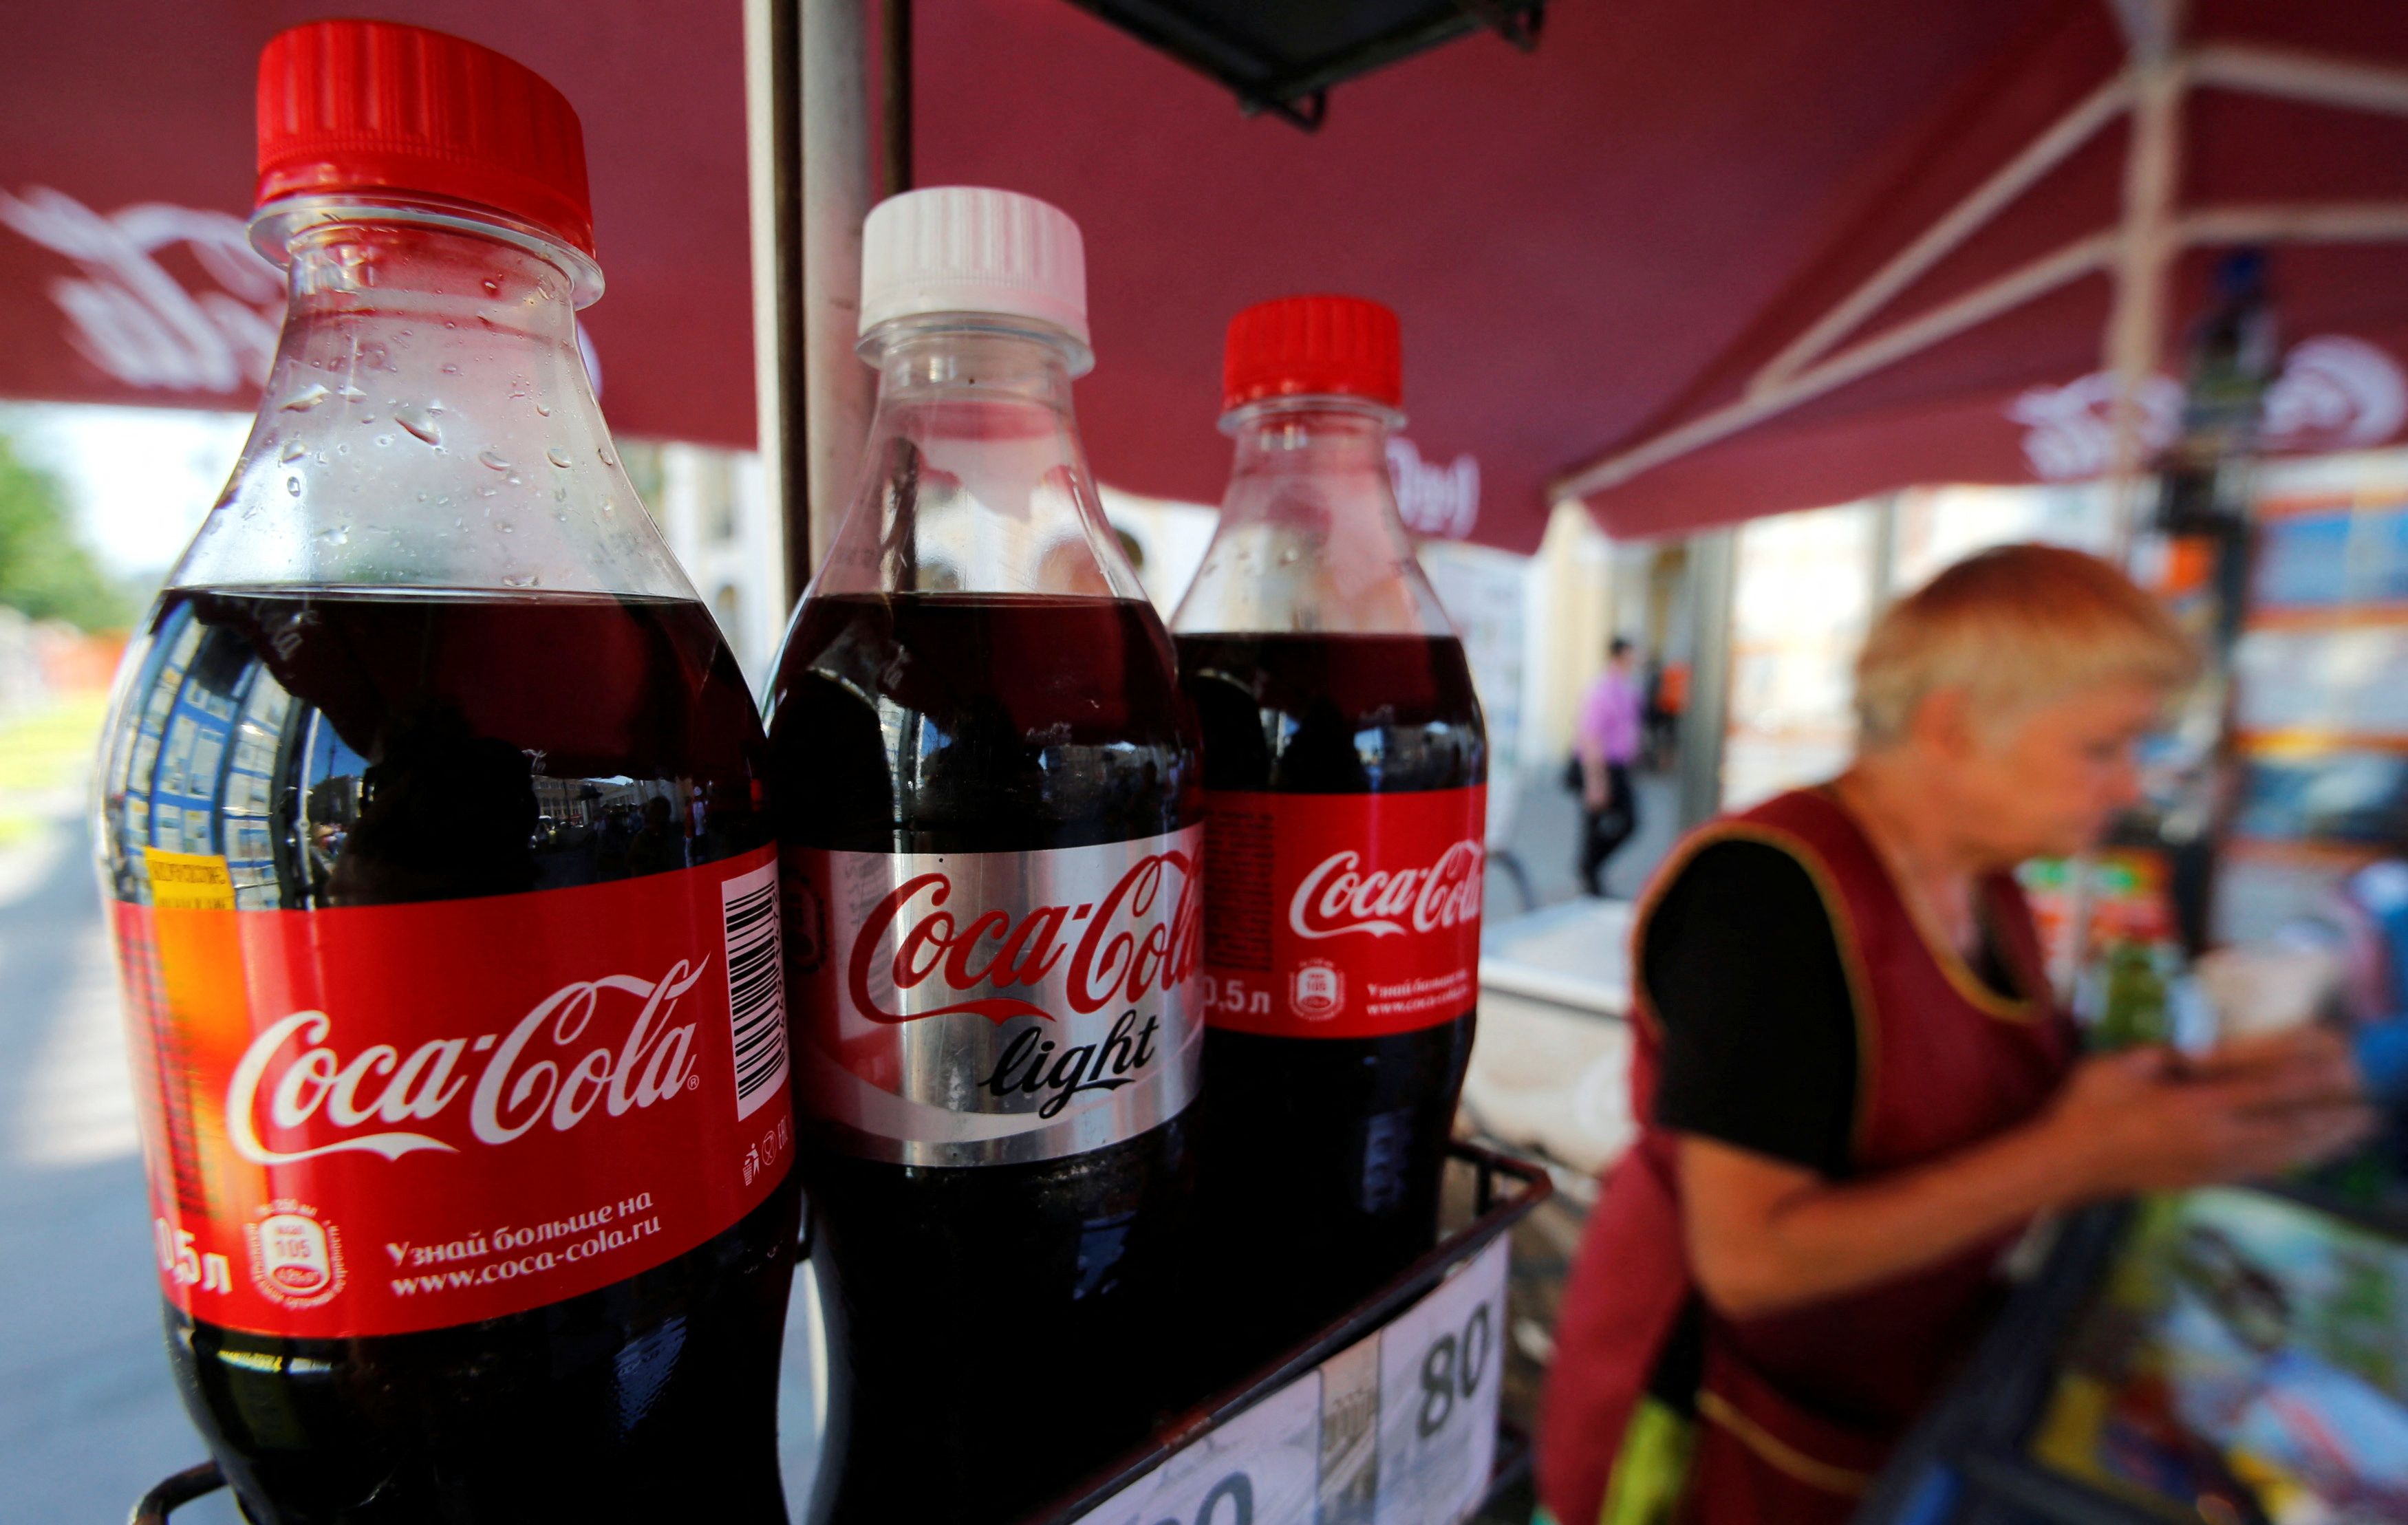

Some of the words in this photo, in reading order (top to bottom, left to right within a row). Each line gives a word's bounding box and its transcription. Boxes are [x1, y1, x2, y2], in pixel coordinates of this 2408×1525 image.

[978, 1008, 1160, 1119] light
[385, 1229, 489, 1268] Узнай
[493, 1205, 612, 1251] больше
[619, 1191, 653, 1218] на
[389, 1215, 661, 1297] www.coca-cola.ru
[1417, 1300, 1490, 1439] 80
